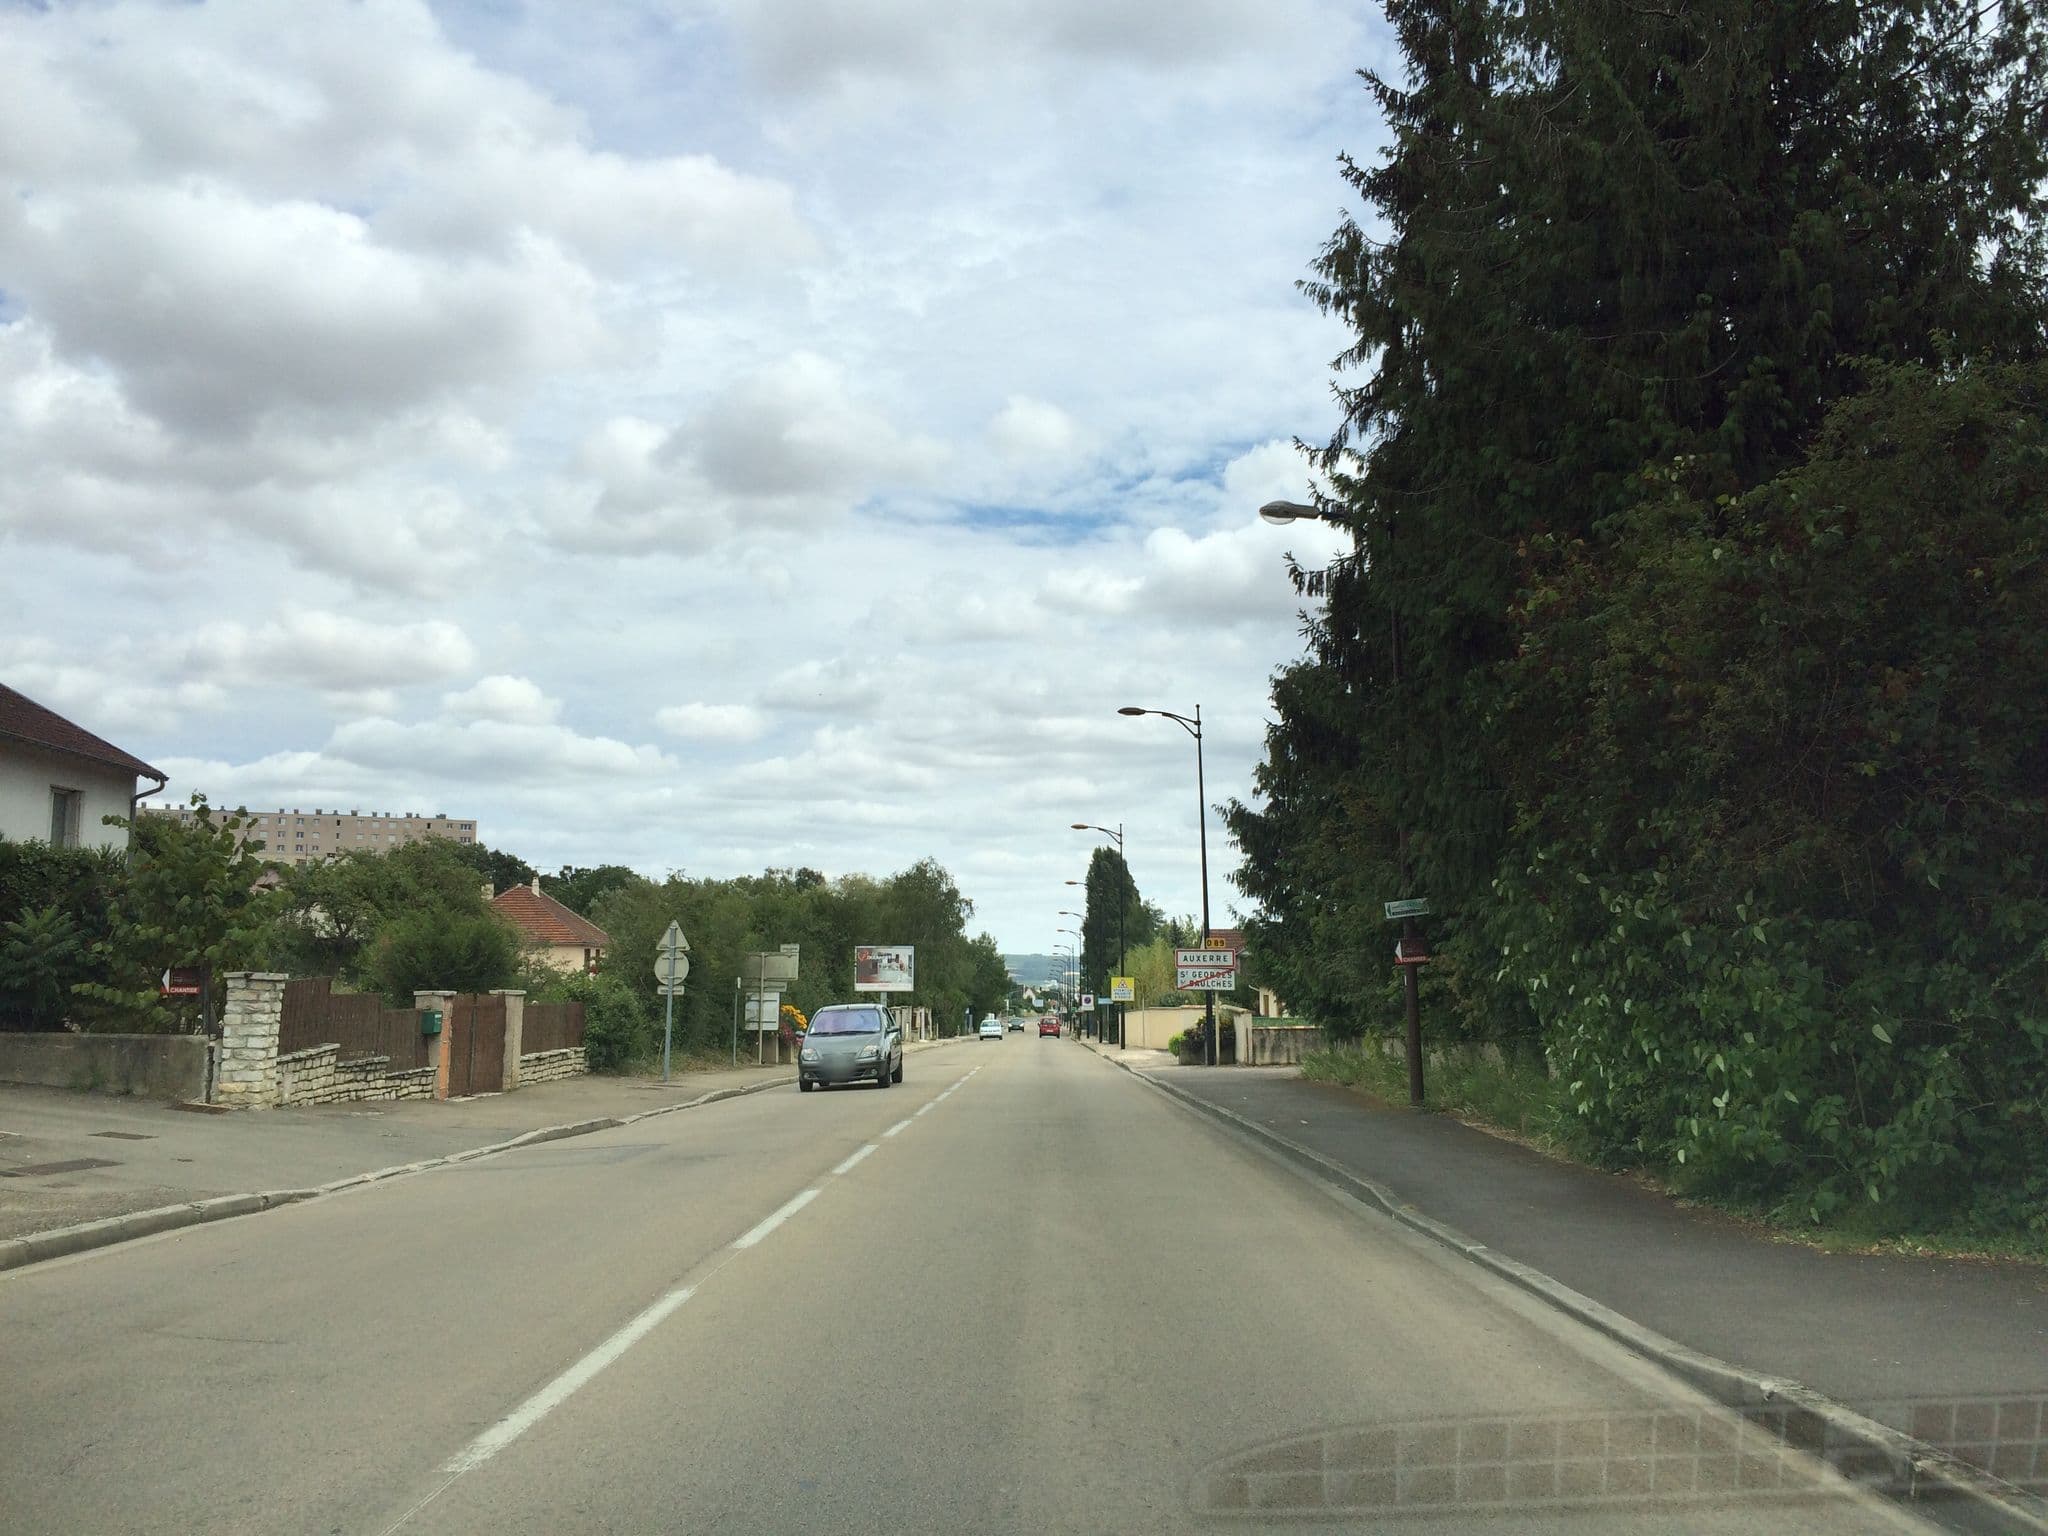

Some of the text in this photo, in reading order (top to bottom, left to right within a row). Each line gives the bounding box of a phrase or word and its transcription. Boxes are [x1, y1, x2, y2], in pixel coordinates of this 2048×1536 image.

[1183, 954, 1228, 962] AUXERRE
[1191, 970, 1232, 979] GEORGES
[1189, 980, 1232, 988] BAULCHES
